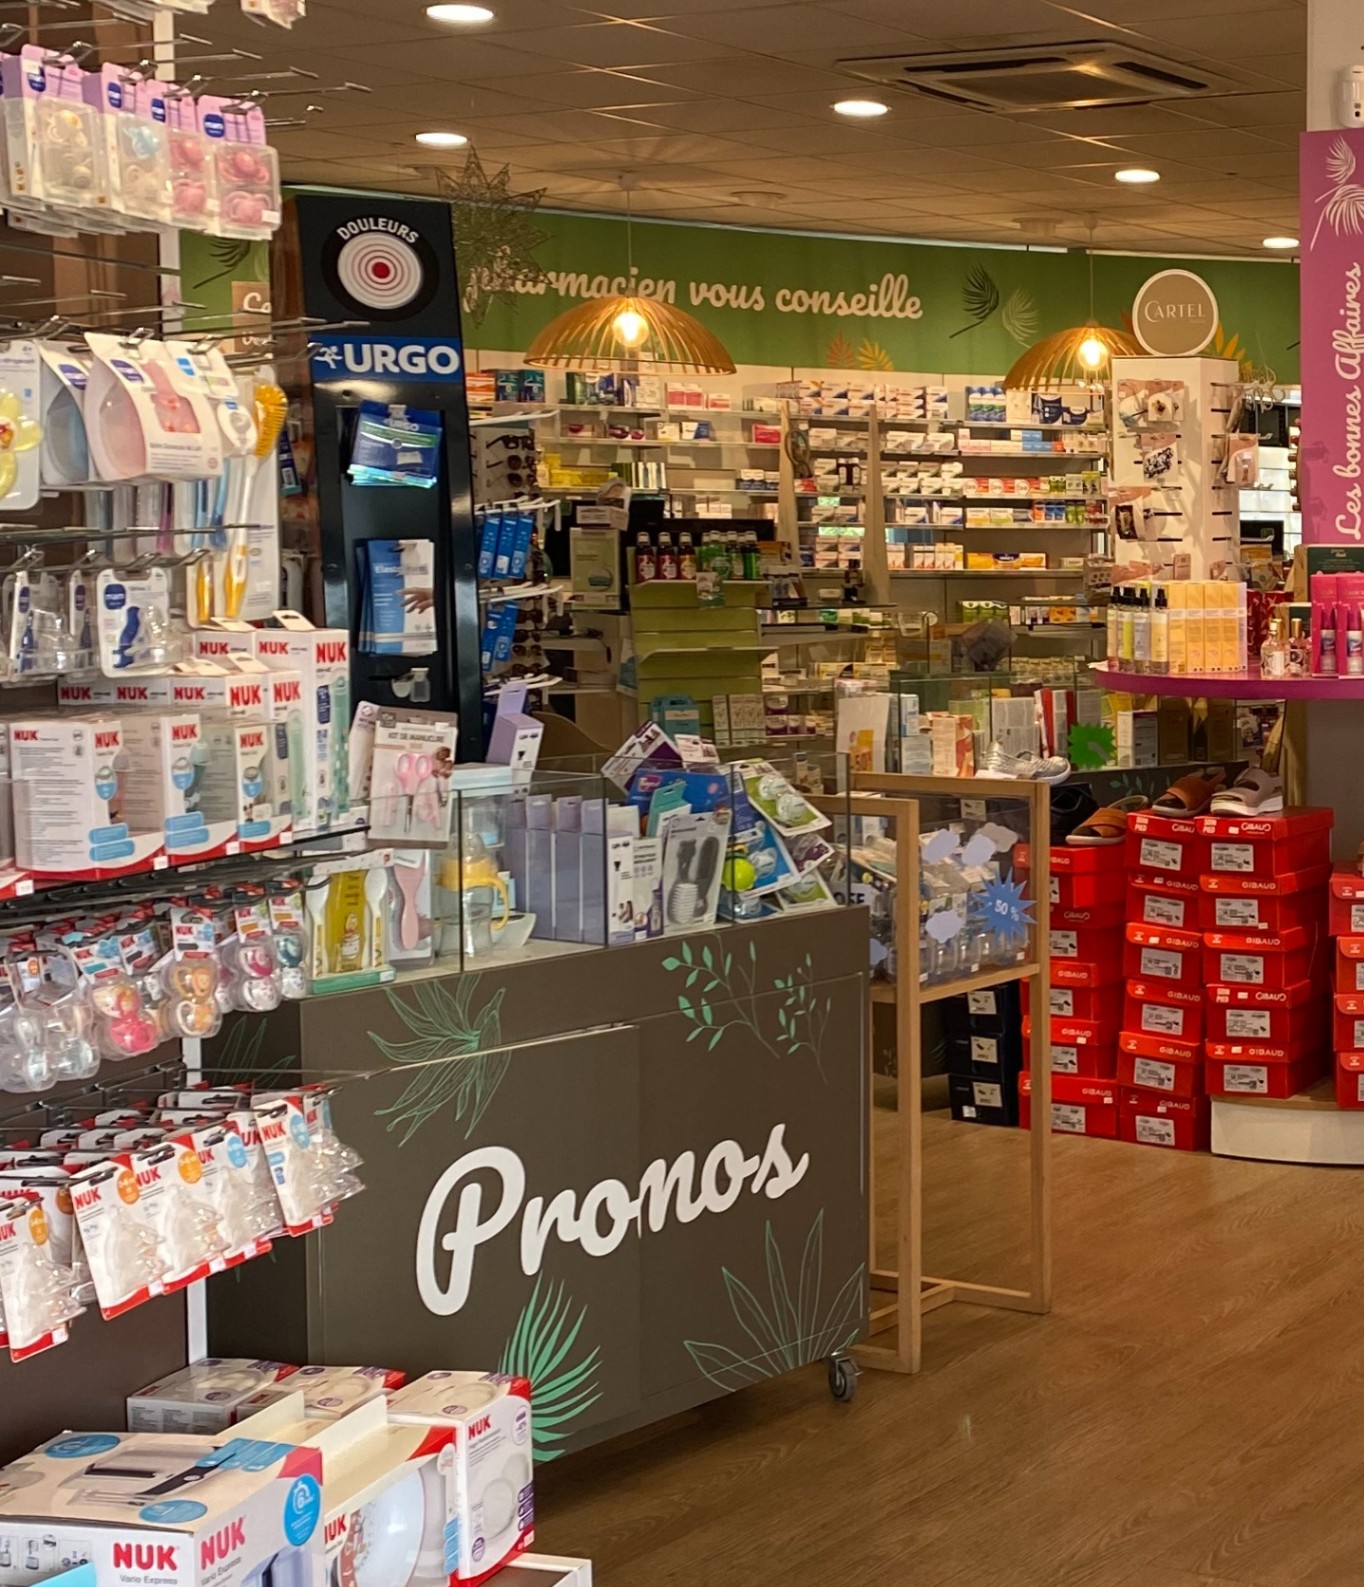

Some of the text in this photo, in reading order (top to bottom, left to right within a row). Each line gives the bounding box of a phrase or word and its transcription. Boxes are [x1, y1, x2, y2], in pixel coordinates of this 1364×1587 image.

[336, 217, 419, 244] DOULEURS
[689, 281, 765, 311] vous
[775, 272, 923, 319] conseille
[1144, 300, 1206, 323] CARTEL
[343, 343, 459, 374] URGO
[1333, 386, 1362, 479] bonnes
[1336, 483, 1362, 540] Les
[200, 642, 228, 655] NUK
[258, 641, 289, 654] NUK
[316, 641, 347, 664] NUK
[60, 686, 91, 700] NUK
[117, 686, 148, 700] NUK
[173, 686, 205, 700] NUK
[230, 685, 262, 707] NUK
[273, 681, 300, 702] NUK
[14, 730, 39, 741] NUK
[95, 731, 120, 748] NUK
[172, 724, 197, 740] NUK
[239, 732, 264, 748] NUK
[1240, 822, 1271, 833] GIBAUD
[1166, 879, 1199, 891] GIBAUD
[1241, 881, 1276, 890] GIBAUD
[1166, 936, 1199, 948] GIBAUD
[1245, 937, 1280, 946] GIBAUD
[1058, 970, 1088, 980] GIBAUD
[1167, 990, 1200, 1001] GIBAUD
[1255, 991, 1287, 1001] GIBAUD
[1061, 1027, 1092, 1038] GIBAUD
[1159, 1046, 1192, 1058] GIBAUD
[1248, 1048, 1285, 1058] GIBAUD
[1082, 1087, 1112, 1097] GIBAUD
[261, 1122, 286, 1140] NUK
[74, 1187, 102, 1209] NUK
[416, 1123, 809, 1316] Pronos
[468, 1414, 491, 1440] NUK
[201, 1517, 246, 1571] NUK
[113, 1543, 177, 1571] NUK
[217, 1556, 241, 1579] Express
[120, 1574, 178, 1586] Vario Express
